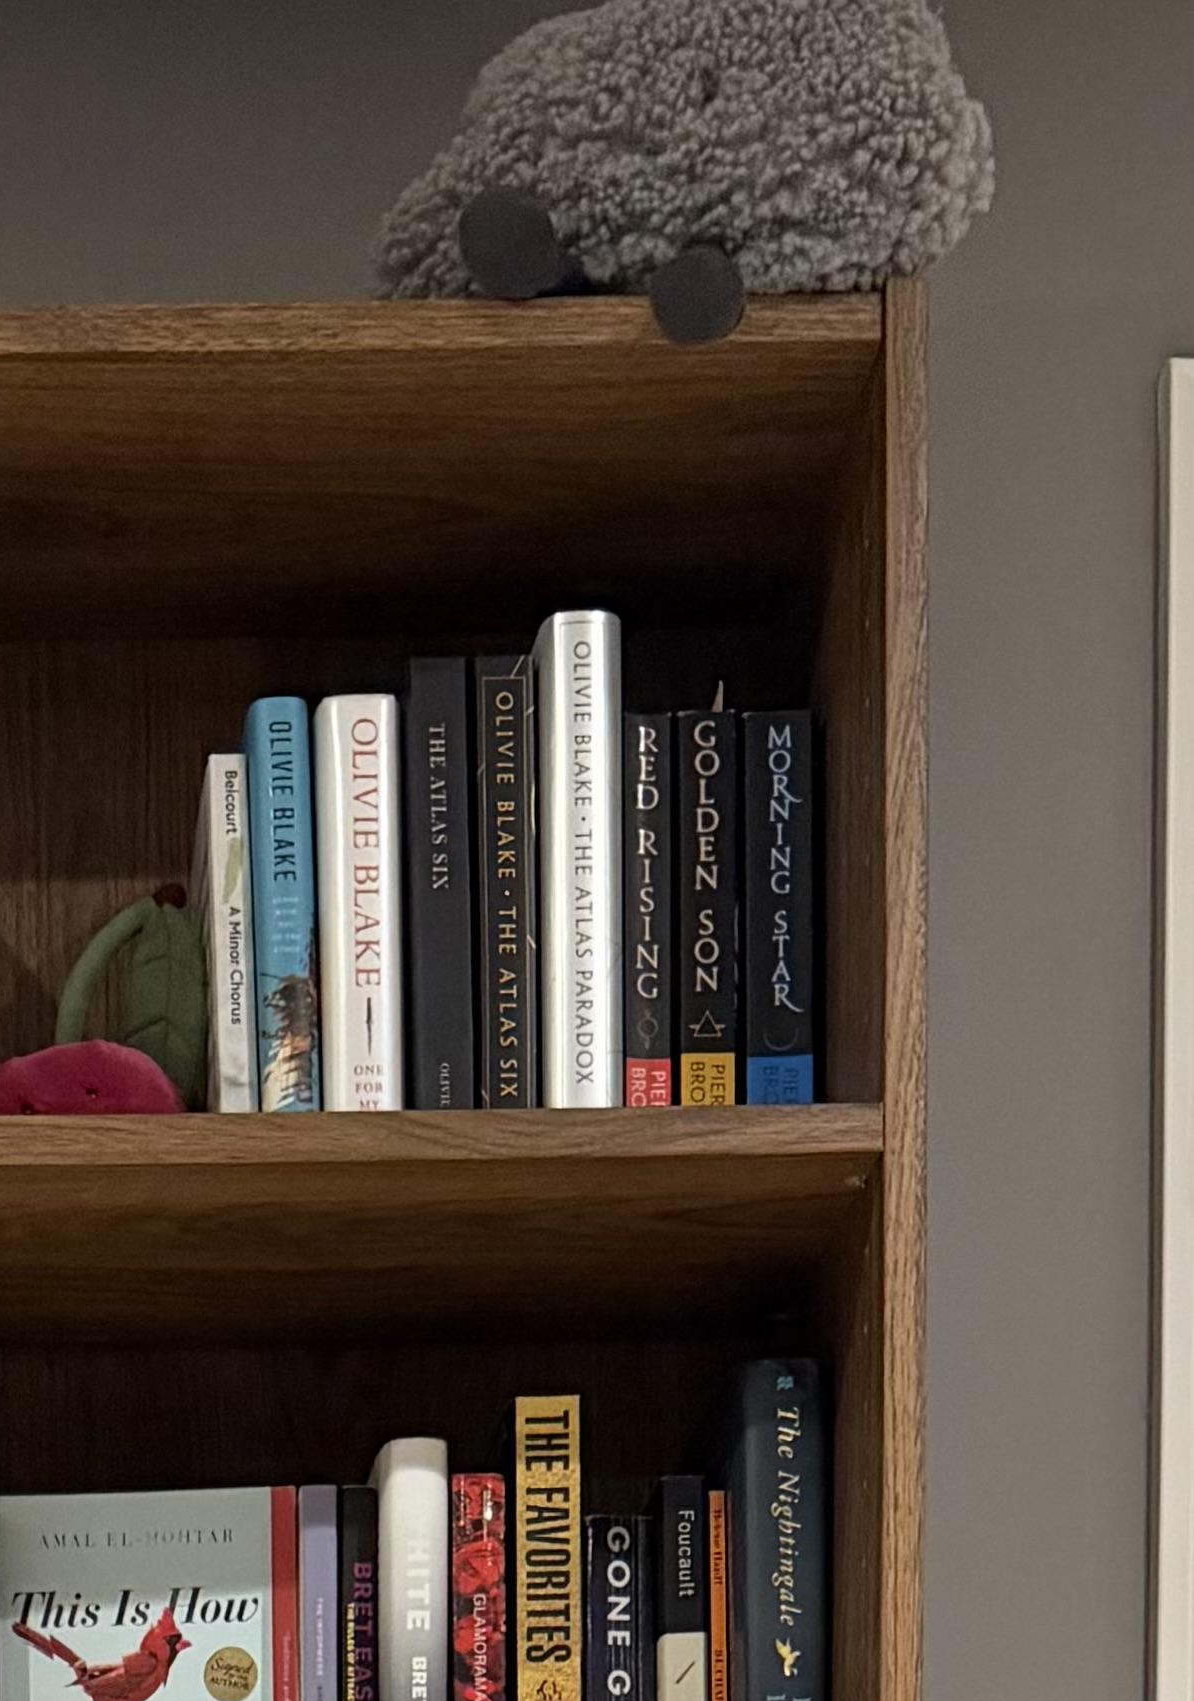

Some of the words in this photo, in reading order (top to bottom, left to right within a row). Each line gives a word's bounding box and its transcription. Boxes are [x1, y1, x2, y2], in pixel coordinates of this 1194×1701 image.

[573, 640, 591, 722] OLIVIE
[224, 770, 237, 834] Belcourt
[574, 735, 592, 808] BLAKE
[636, 726, 659, 810] RED
[694, 721, 720, 890] GOLDEN
[767, 726, 802, 894] MORNING
[574, 830, 592, 876] THE
[229, 907, 240, 915] A
[229, 921, 241, 965] Minor
[574, 886, 593, 958] ATLAS
[636, 830, 660, 1000] RISING
[694, 909, 719, 992] SON
[229, 971, 242, 1025] Chorus
[772, 912, 803, 1012] STAR
[575, 966, 594, 1085] PARADOX
[525, 1410, 570, 1472] THE
[525, 1486, 571, 1664] FAVORITES
[607, 1526, 630, 1647] GONE
[678, 1510, 694, 1598] Foucault
[11, 1591, 101, 1628] This
[111, 1589, 151, 1627] Is
[167, 1587, 258, 1625] How
